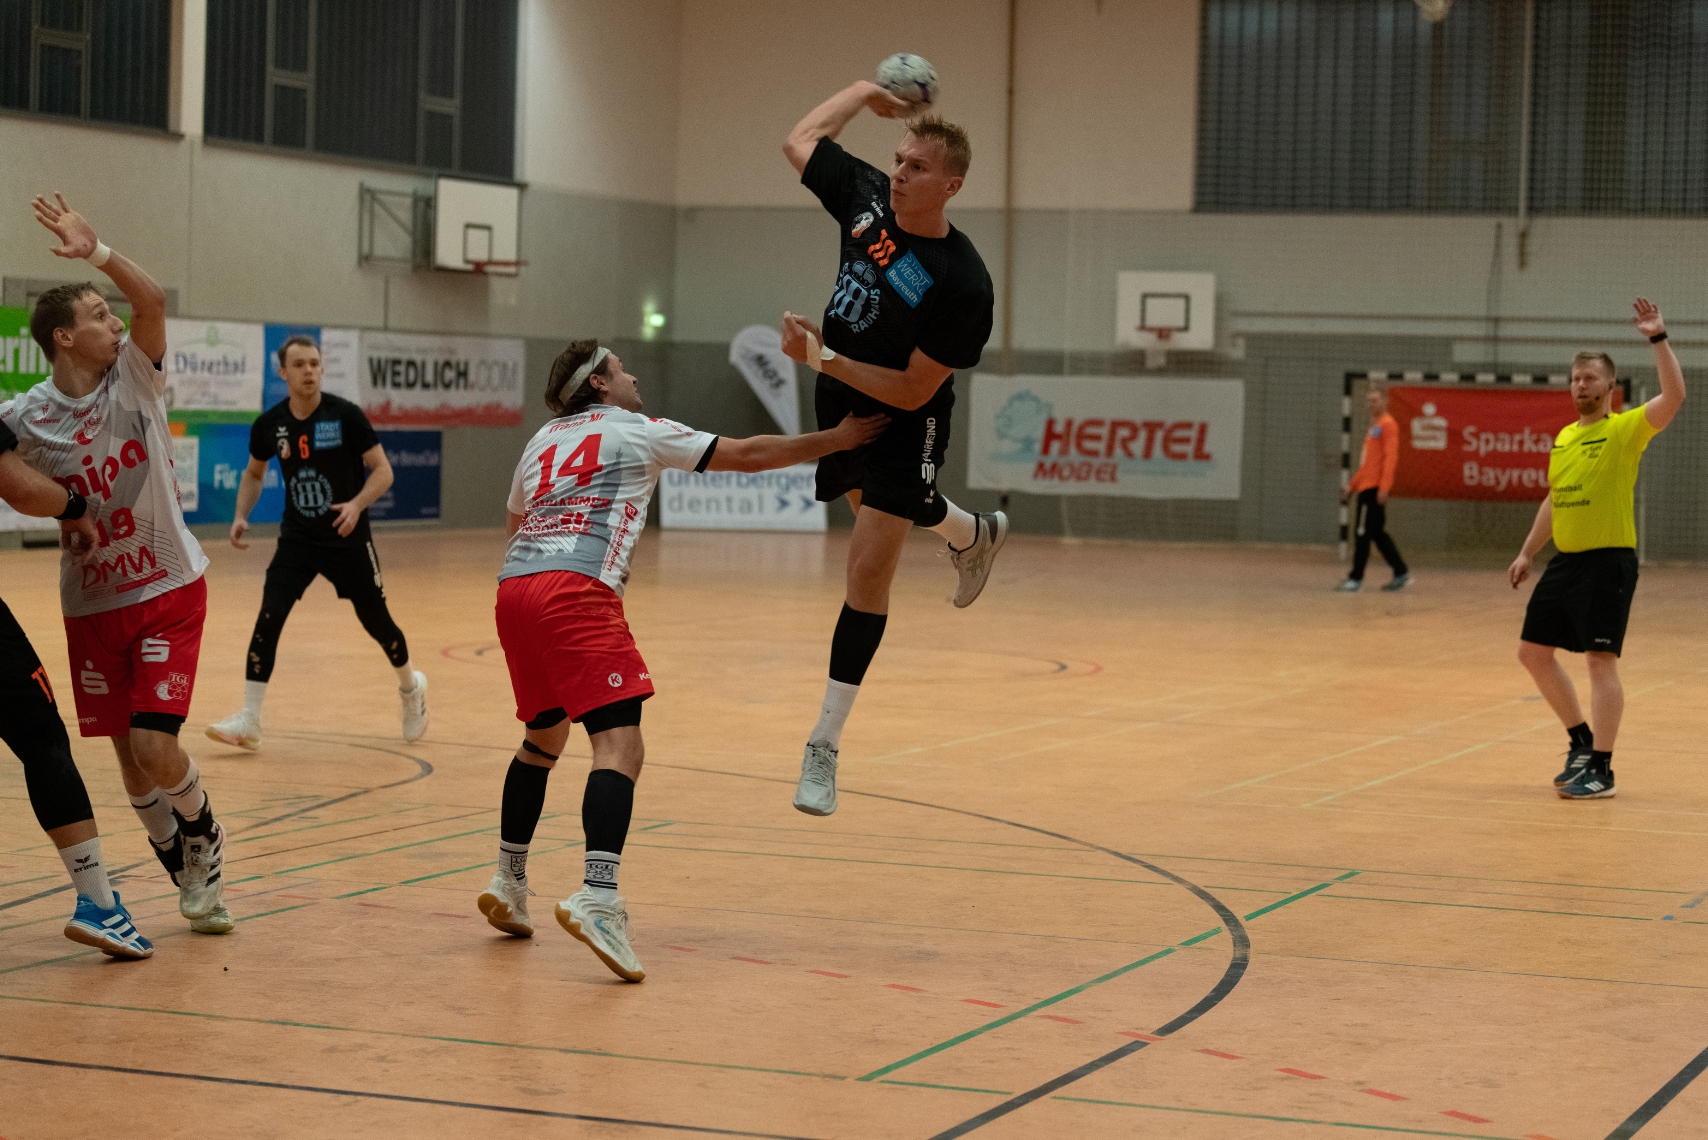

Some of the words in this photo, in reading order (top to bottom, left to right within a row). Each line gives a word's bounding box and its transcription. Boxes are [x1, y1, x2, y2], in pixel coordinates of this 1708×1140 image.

[888, 268, 919, 303] Bayreuth
[368, 355, 520, 392] WEDLICH.COM
[298, 433, 310, 460] 6
[1040, 418, 1213, 461] HERTEL
[531, 433, 603, 501] 14
[667, 491, 764, 515] dental
[81, 545, 158, 591] DMW
[73, 861, 99, 873] erima
